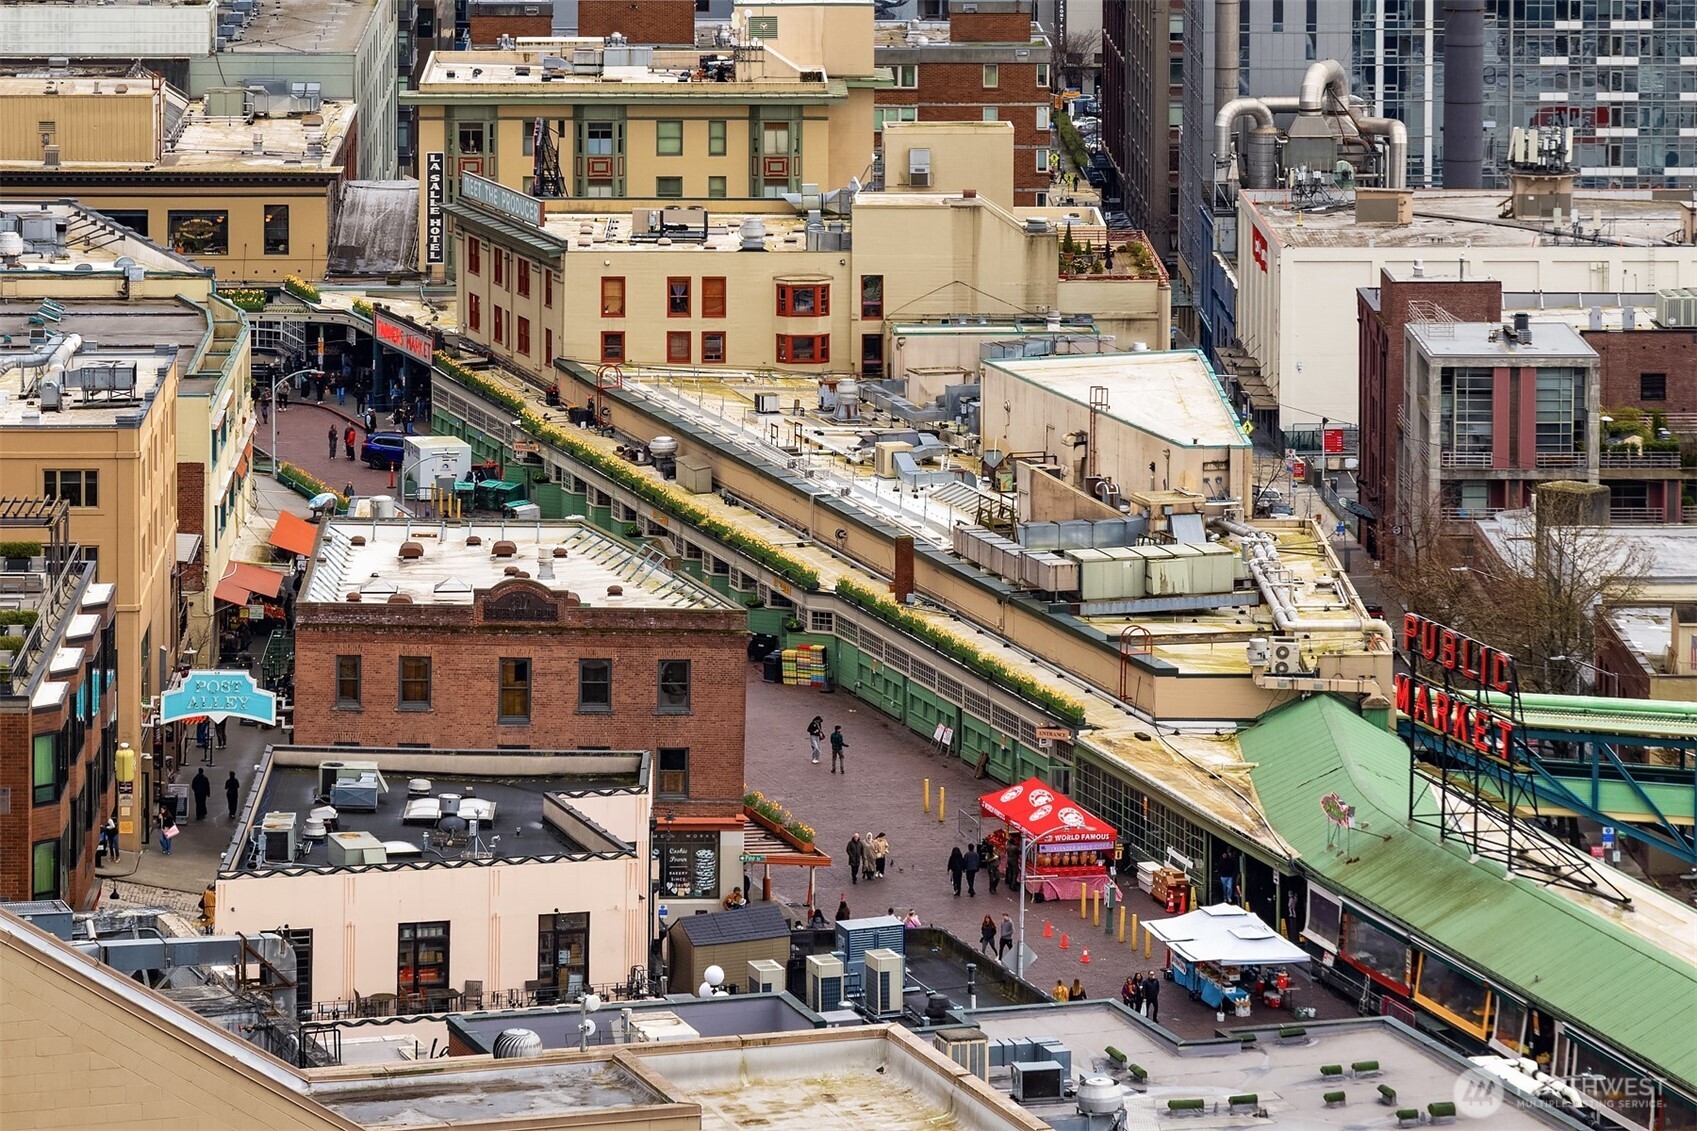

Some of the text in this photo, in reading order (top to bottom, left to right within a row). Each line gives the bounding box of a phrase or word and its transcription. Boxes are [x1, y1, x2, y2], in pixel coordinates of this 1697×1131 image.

[429, 155, 441, 260] LA SALLE HOTEL
[464, 176, 539, 221] MEET THE PRODUCER
[405, 334, 432, 360] MARKET
[1404, 612, 1509, 693] PUBLIC
[195, 679, 243, 694] POST
[187, 695, 250, 710] ALLEY
[1395, 673, 1514, 761] MARKET
[1039, 730, 1066, 738] ENTRANCE
[1054, 833, 1110, 842] WORLD FAMOUS
[669, 847, 688, 855] Cookie
